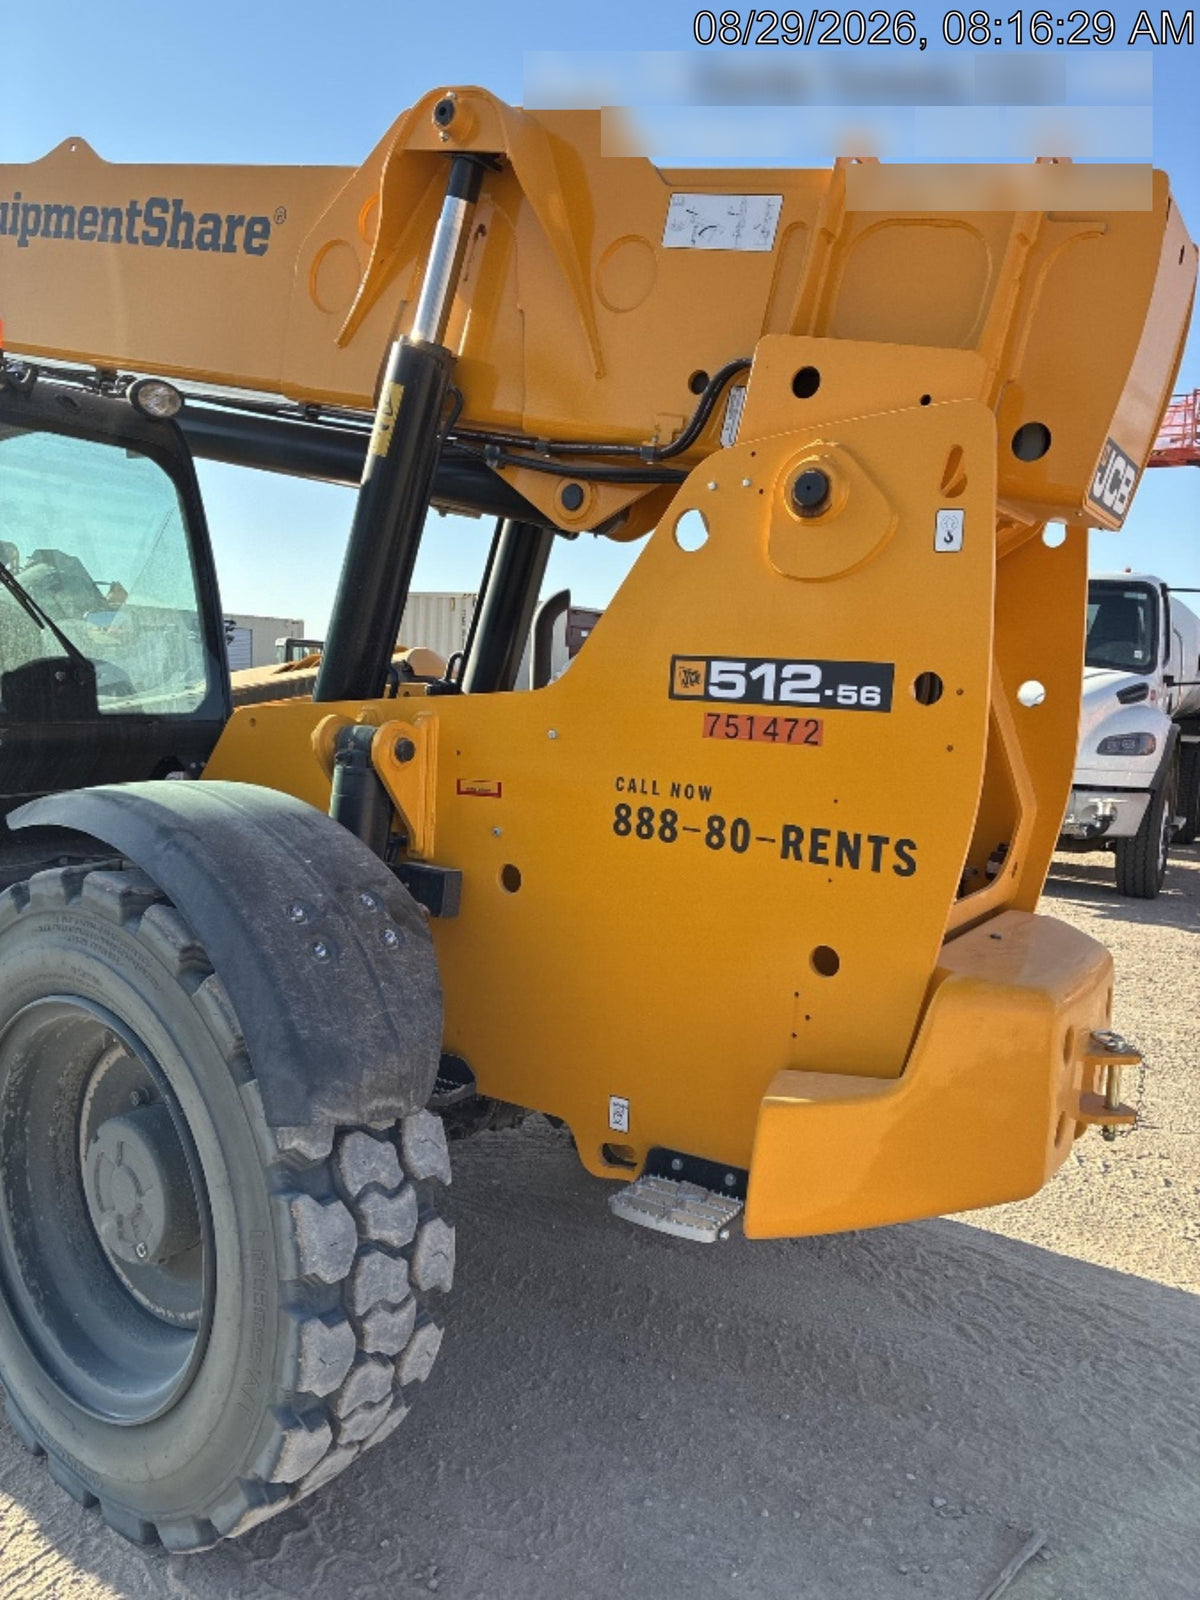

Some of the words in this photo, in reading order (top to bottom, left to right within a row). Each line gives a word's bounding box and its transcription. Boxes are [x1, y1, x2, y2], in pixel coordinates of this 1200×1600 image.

[1093, 450, 1136, 515] JCB
[707, 712, 820, 746] 751472
[615, 776, 661, 797] CALL
[669, 781, 713, 802] NOW
[612, 802, 918, 878] 888-80-RENTS
